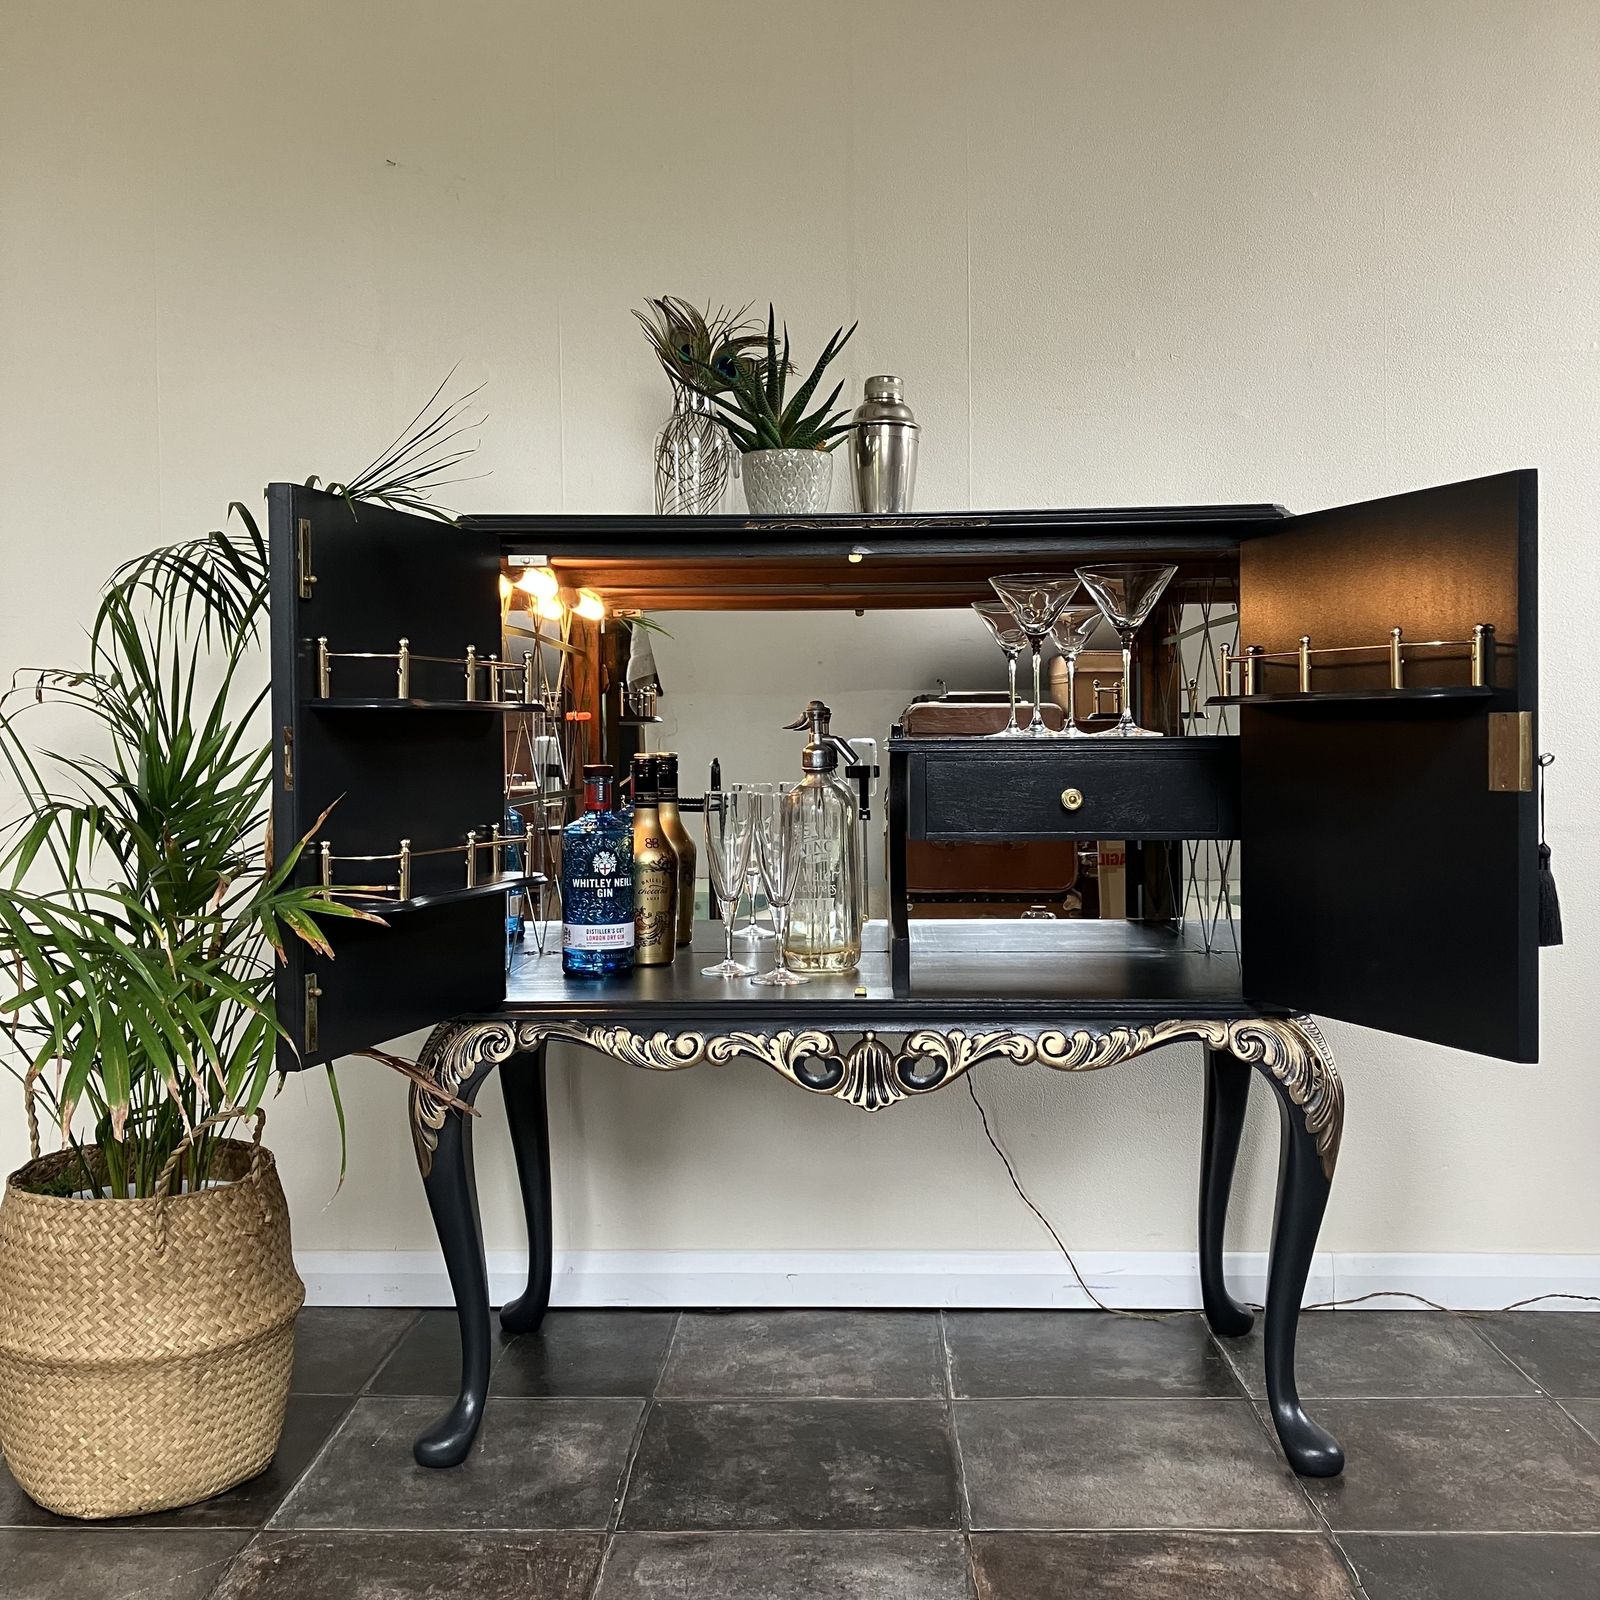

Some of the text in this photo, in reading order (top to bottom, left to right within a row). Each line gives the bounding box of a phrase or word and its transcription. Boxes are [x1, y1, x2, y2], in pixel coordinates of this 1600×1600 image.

[572, 877, 632, 888] WHITLEY NEILL
[597, 888, 613, 898] GIN
